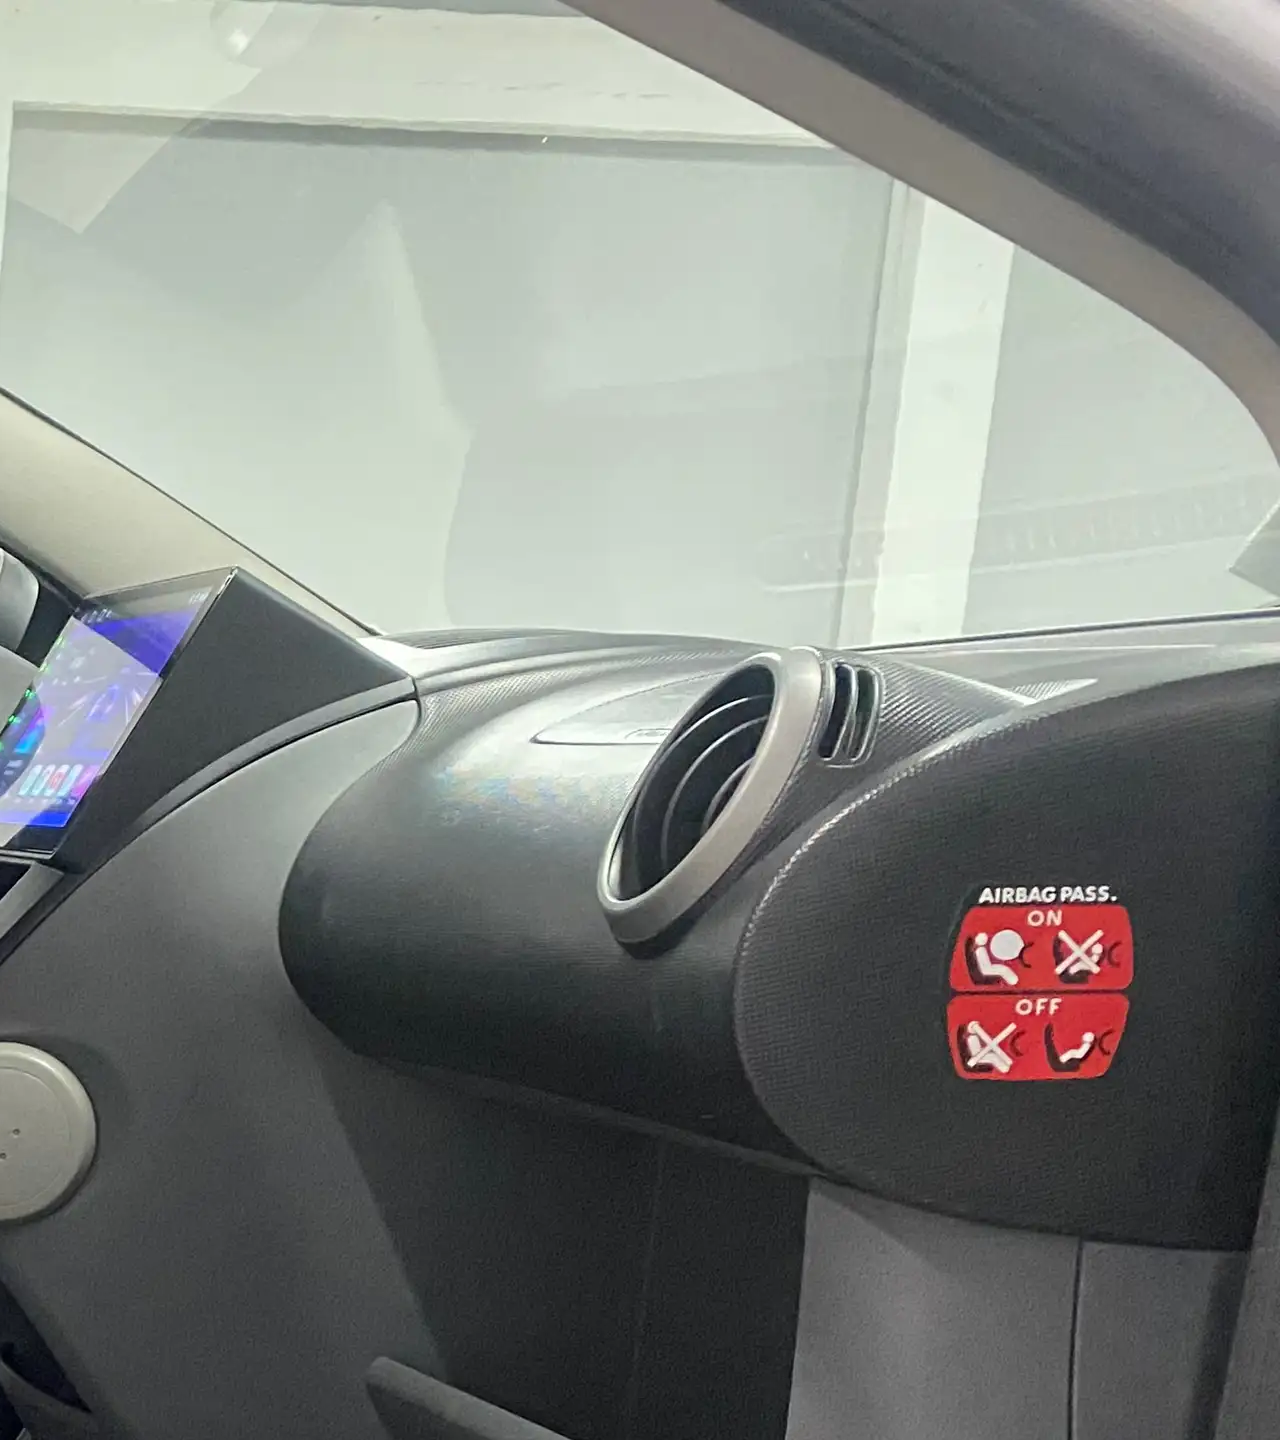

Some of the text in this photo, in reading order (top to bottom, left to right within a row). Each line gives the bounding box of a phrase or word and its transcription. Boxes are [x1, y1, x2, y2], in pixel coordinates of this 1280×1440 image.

[978, 886, 1118, 904] AIRBAG PASS.
[1027, 910, 1062, 927] ON
[1015, 998, 1062, 1015] OFF
